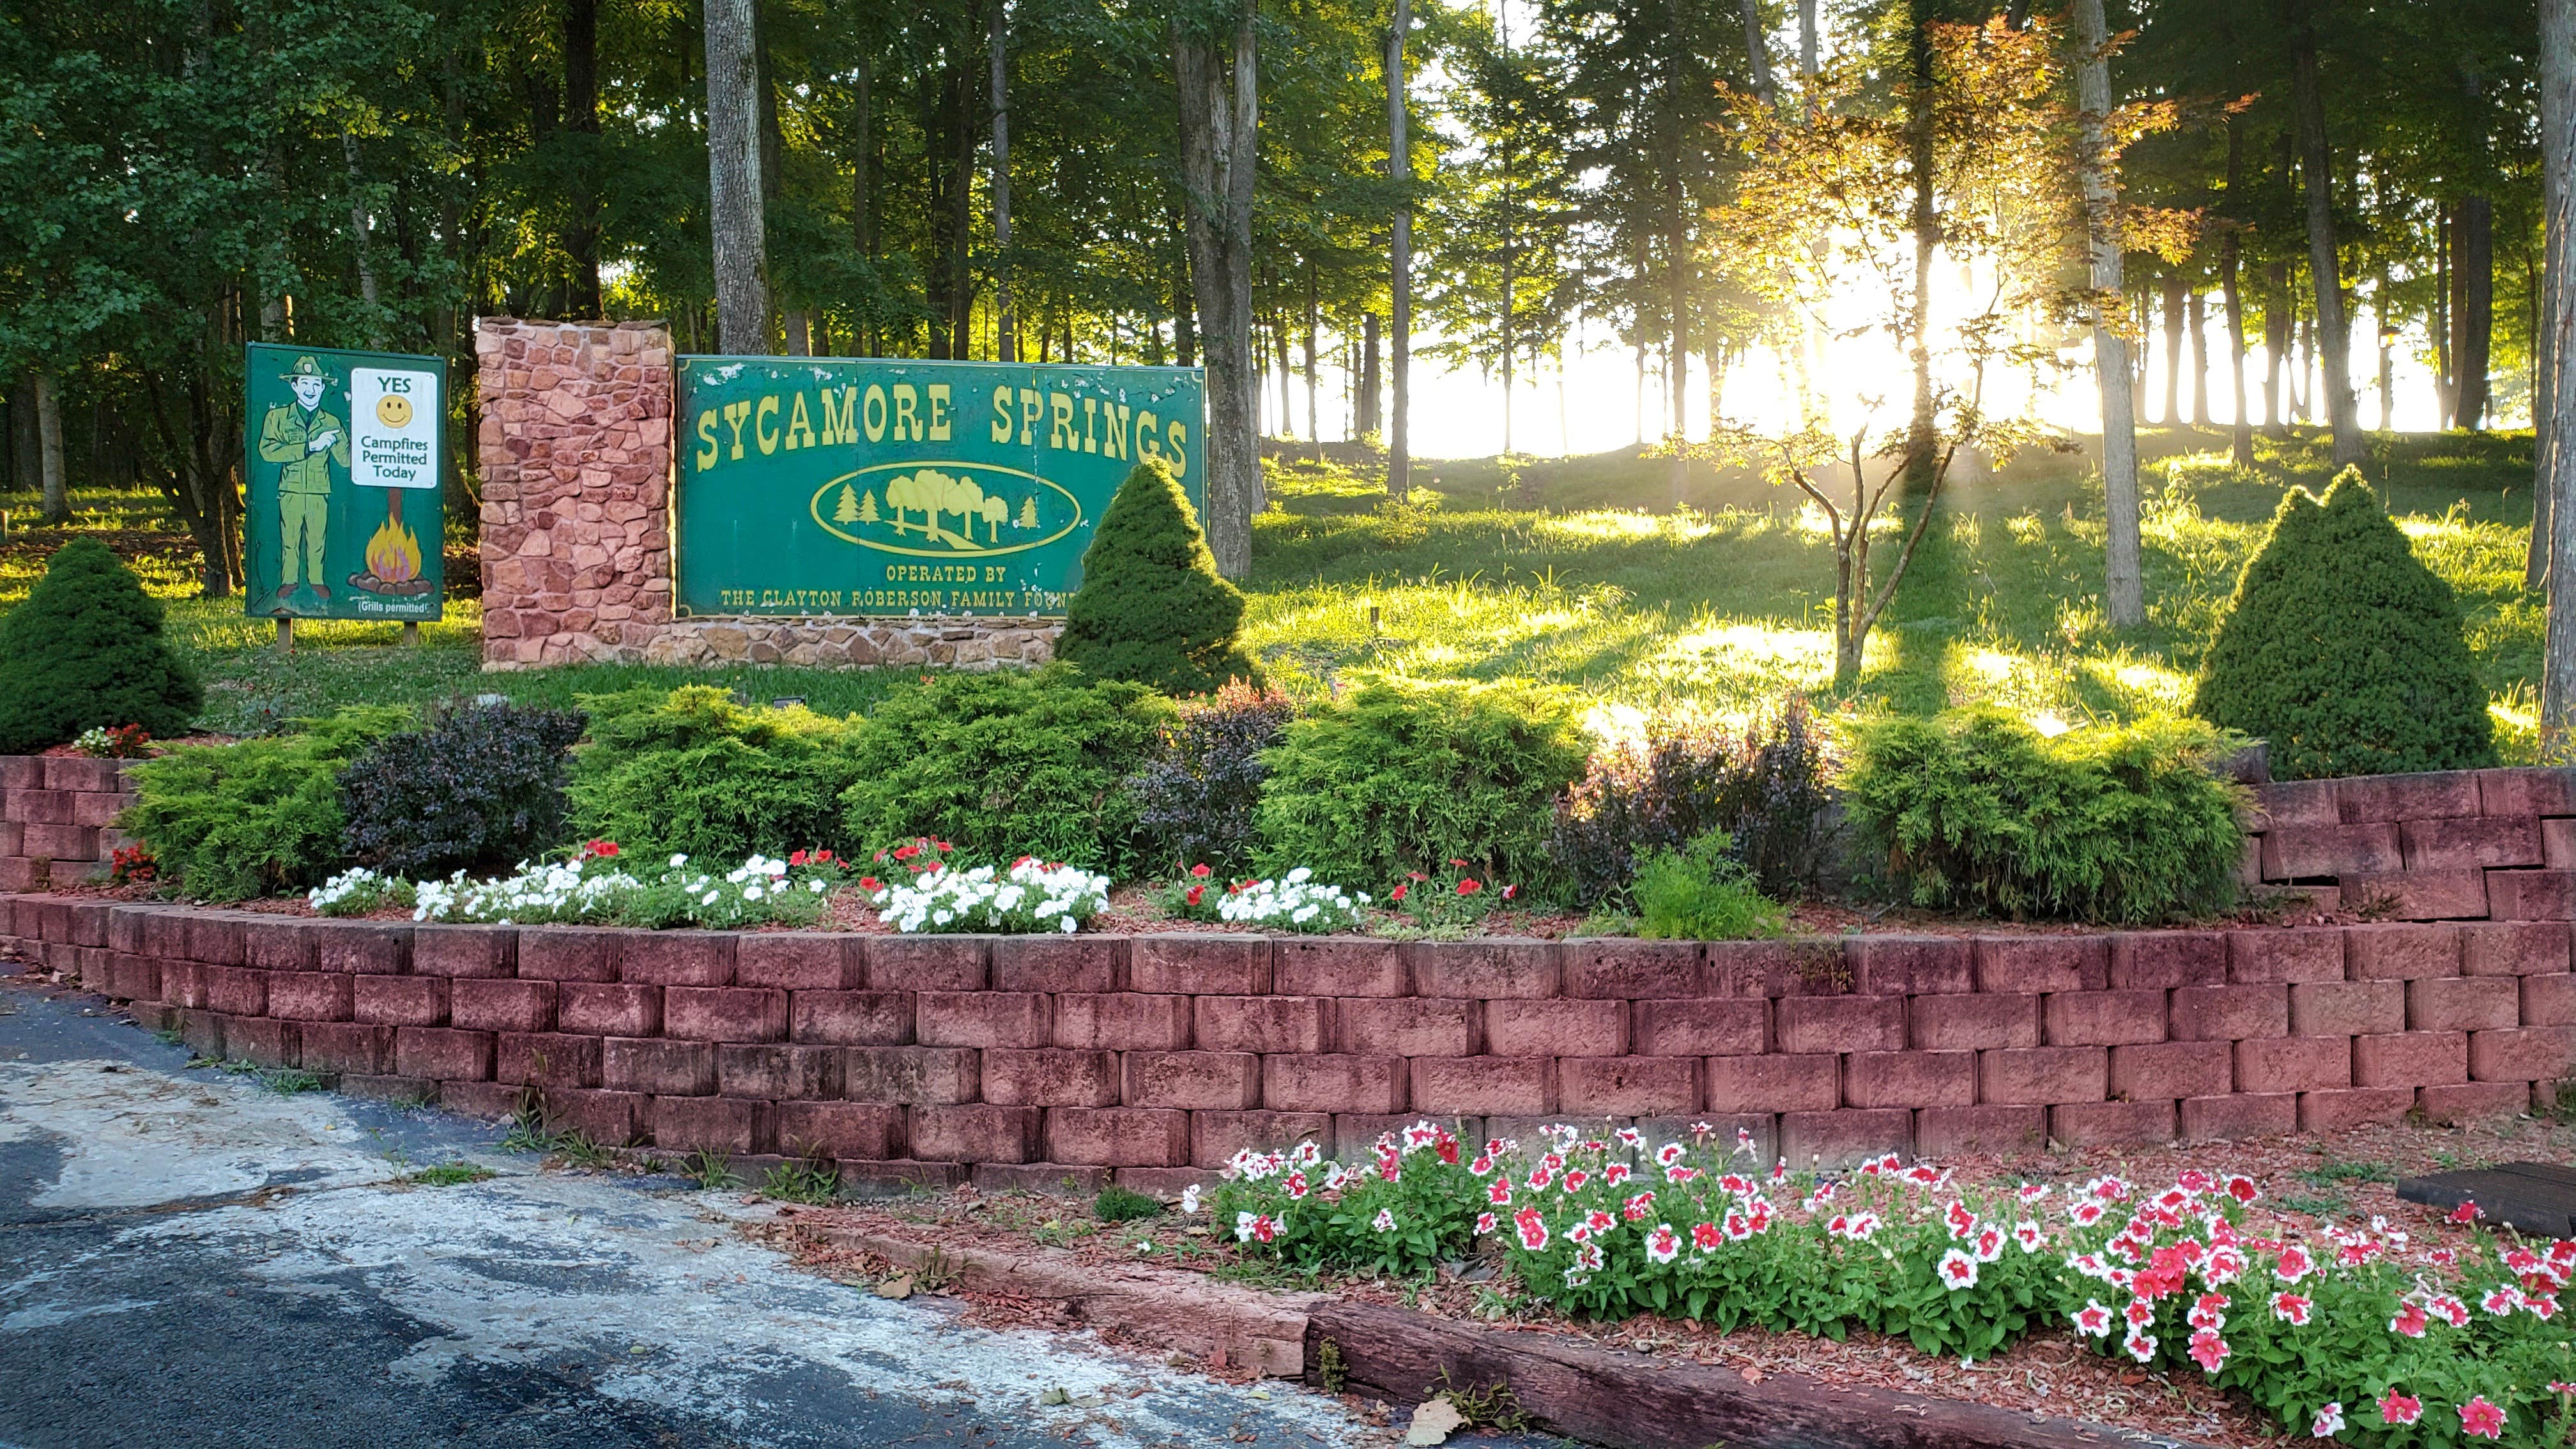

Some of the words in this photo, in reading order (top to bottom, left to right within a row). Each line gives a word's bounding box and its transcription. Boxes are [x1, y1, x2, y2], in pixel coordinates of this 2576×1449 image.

[378, 377, 411, 393] YES
[697, 384, 951, 473] SYCAMORE
[992, 385, 1186, 478] SPRINGS
[361, 436, 428, 452] Campfires
[362, 450, 427, 465] Permitted
[373, 465, 417, 481] Today
[886, 565, 976, 582] OPERATED
[985, 566, 1006, 582] BY
[358, 601, 383, 613] (Grills
[721, 590, 755, 606] THE
[763, 590, 841, 606] CLAYTON
[852, 590, 942, 606] ROBERSON
[951, 591, 1015, 607] FAMILY
[1024, 591, 1076, 608] FOUN
